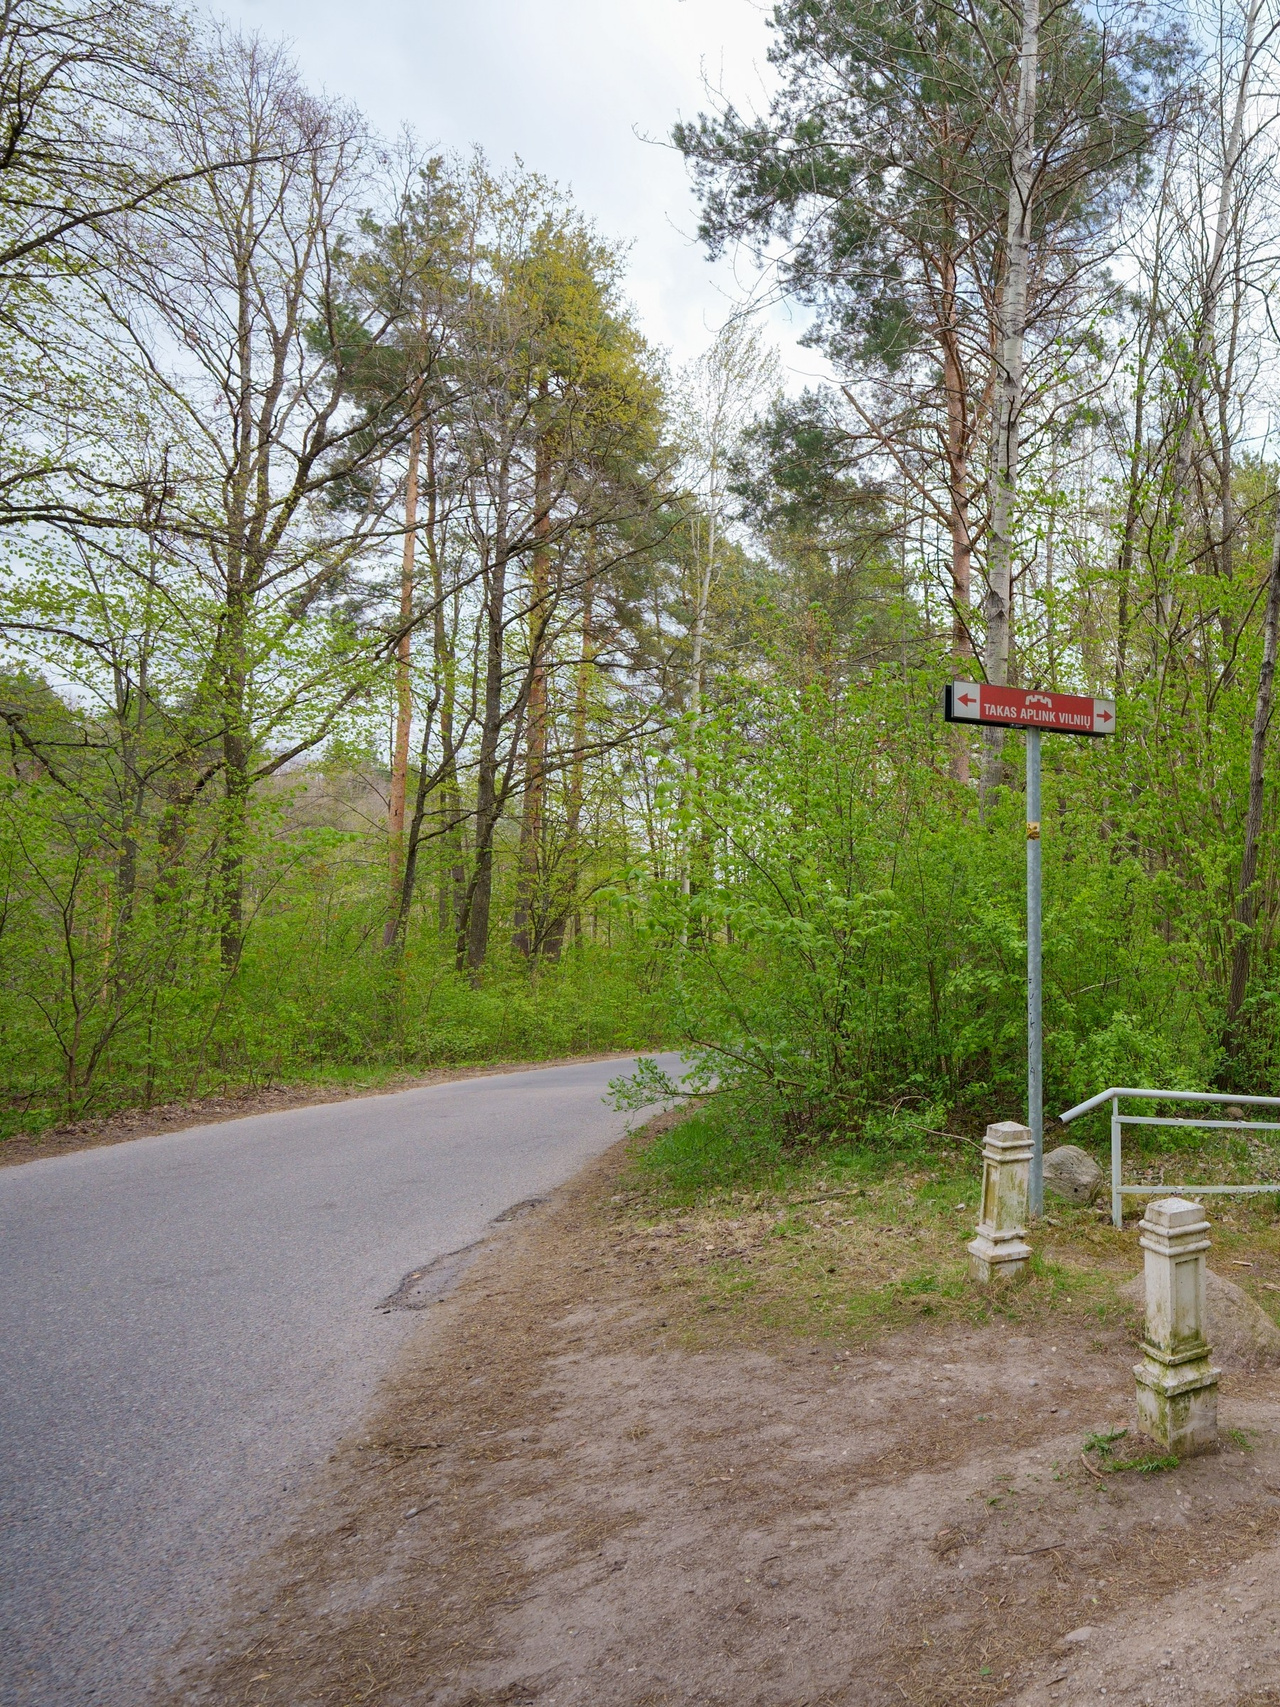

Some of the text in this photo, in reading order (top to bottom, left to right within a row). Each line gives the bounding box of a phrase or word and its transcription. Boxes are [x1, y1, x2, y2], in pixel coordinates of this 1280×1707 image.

[983, 703, 1091, 729] TAKAS APLINK VILNIŲ
